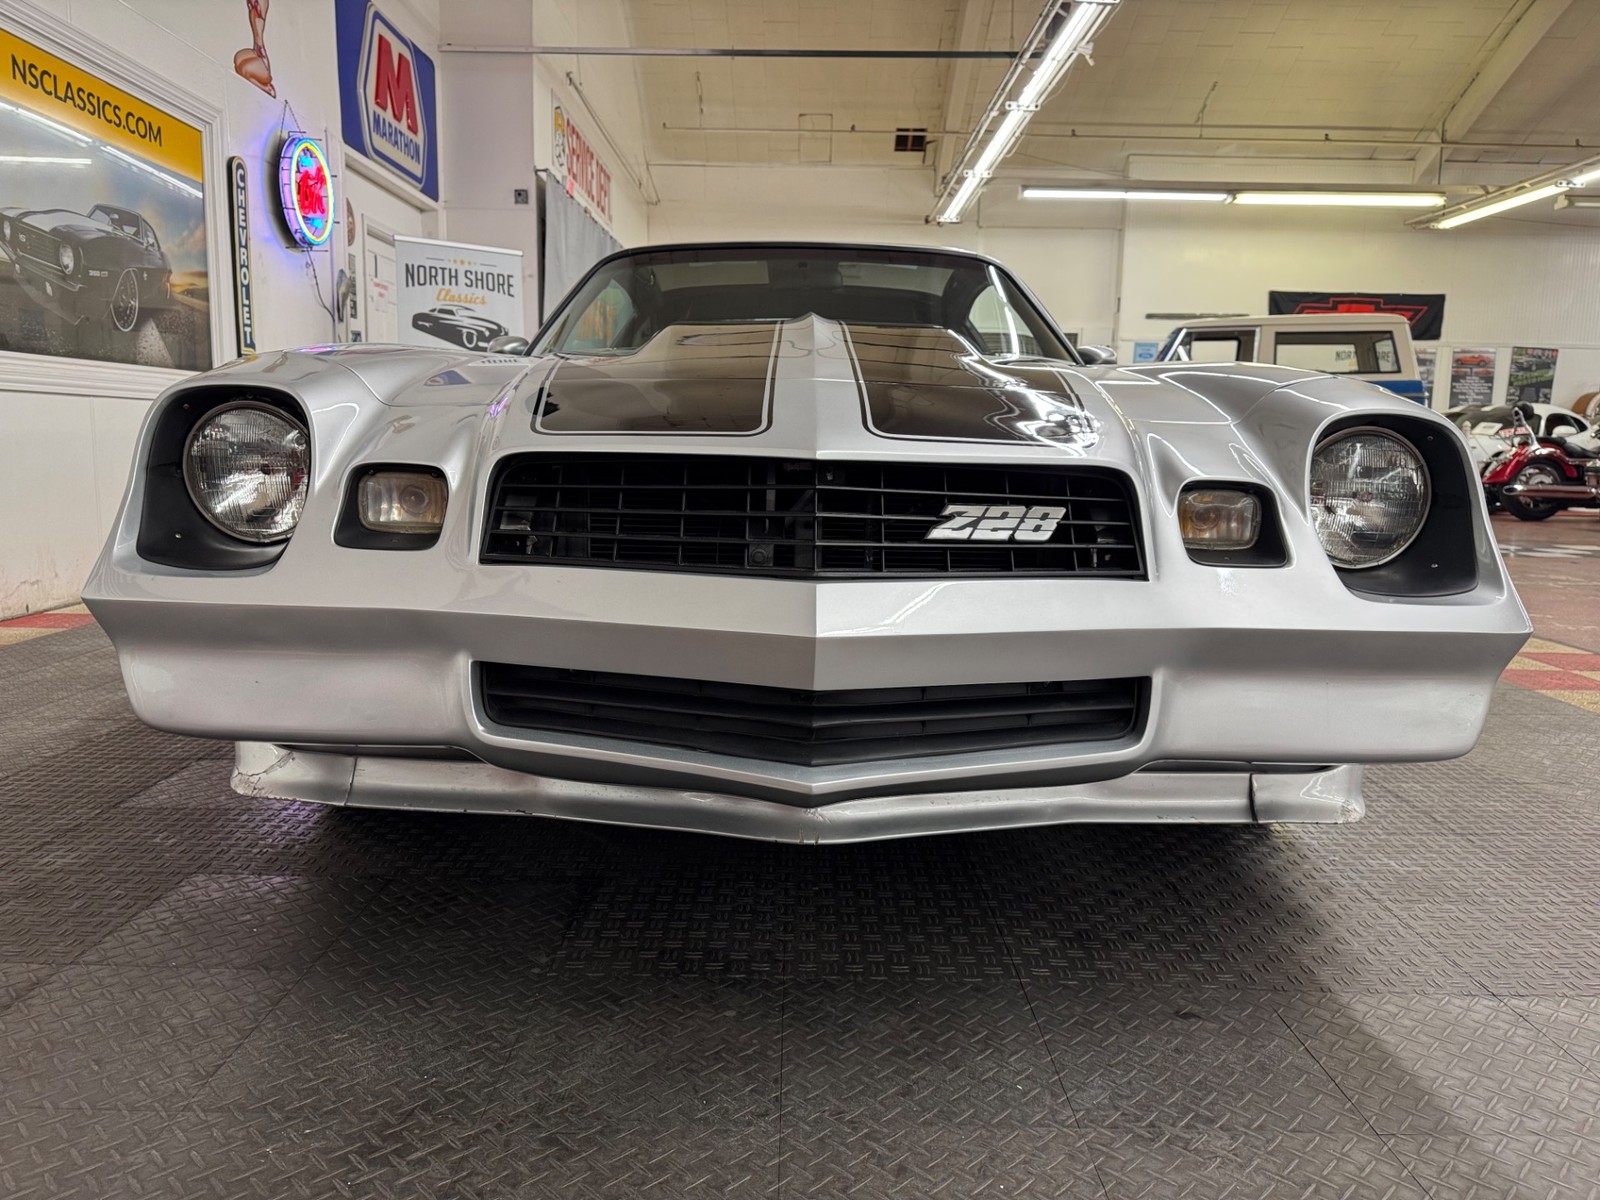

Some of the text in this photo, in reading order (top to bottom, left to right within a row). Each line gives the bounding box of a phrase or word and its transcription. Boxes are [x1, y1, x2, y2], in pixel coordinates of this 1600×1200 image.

[11, 53, 162, 148] NSCLASSICS.COM
[374, 33, 418, 136] M
[373, 110, 420, 165] MARATHON
[236, 168, 252, 344] CHEVROLET
[405, 263, 515, 298] NORTH SHORE
[435, 287, 487, 305] Classics
[925, 504, 1067, 541] Z28
